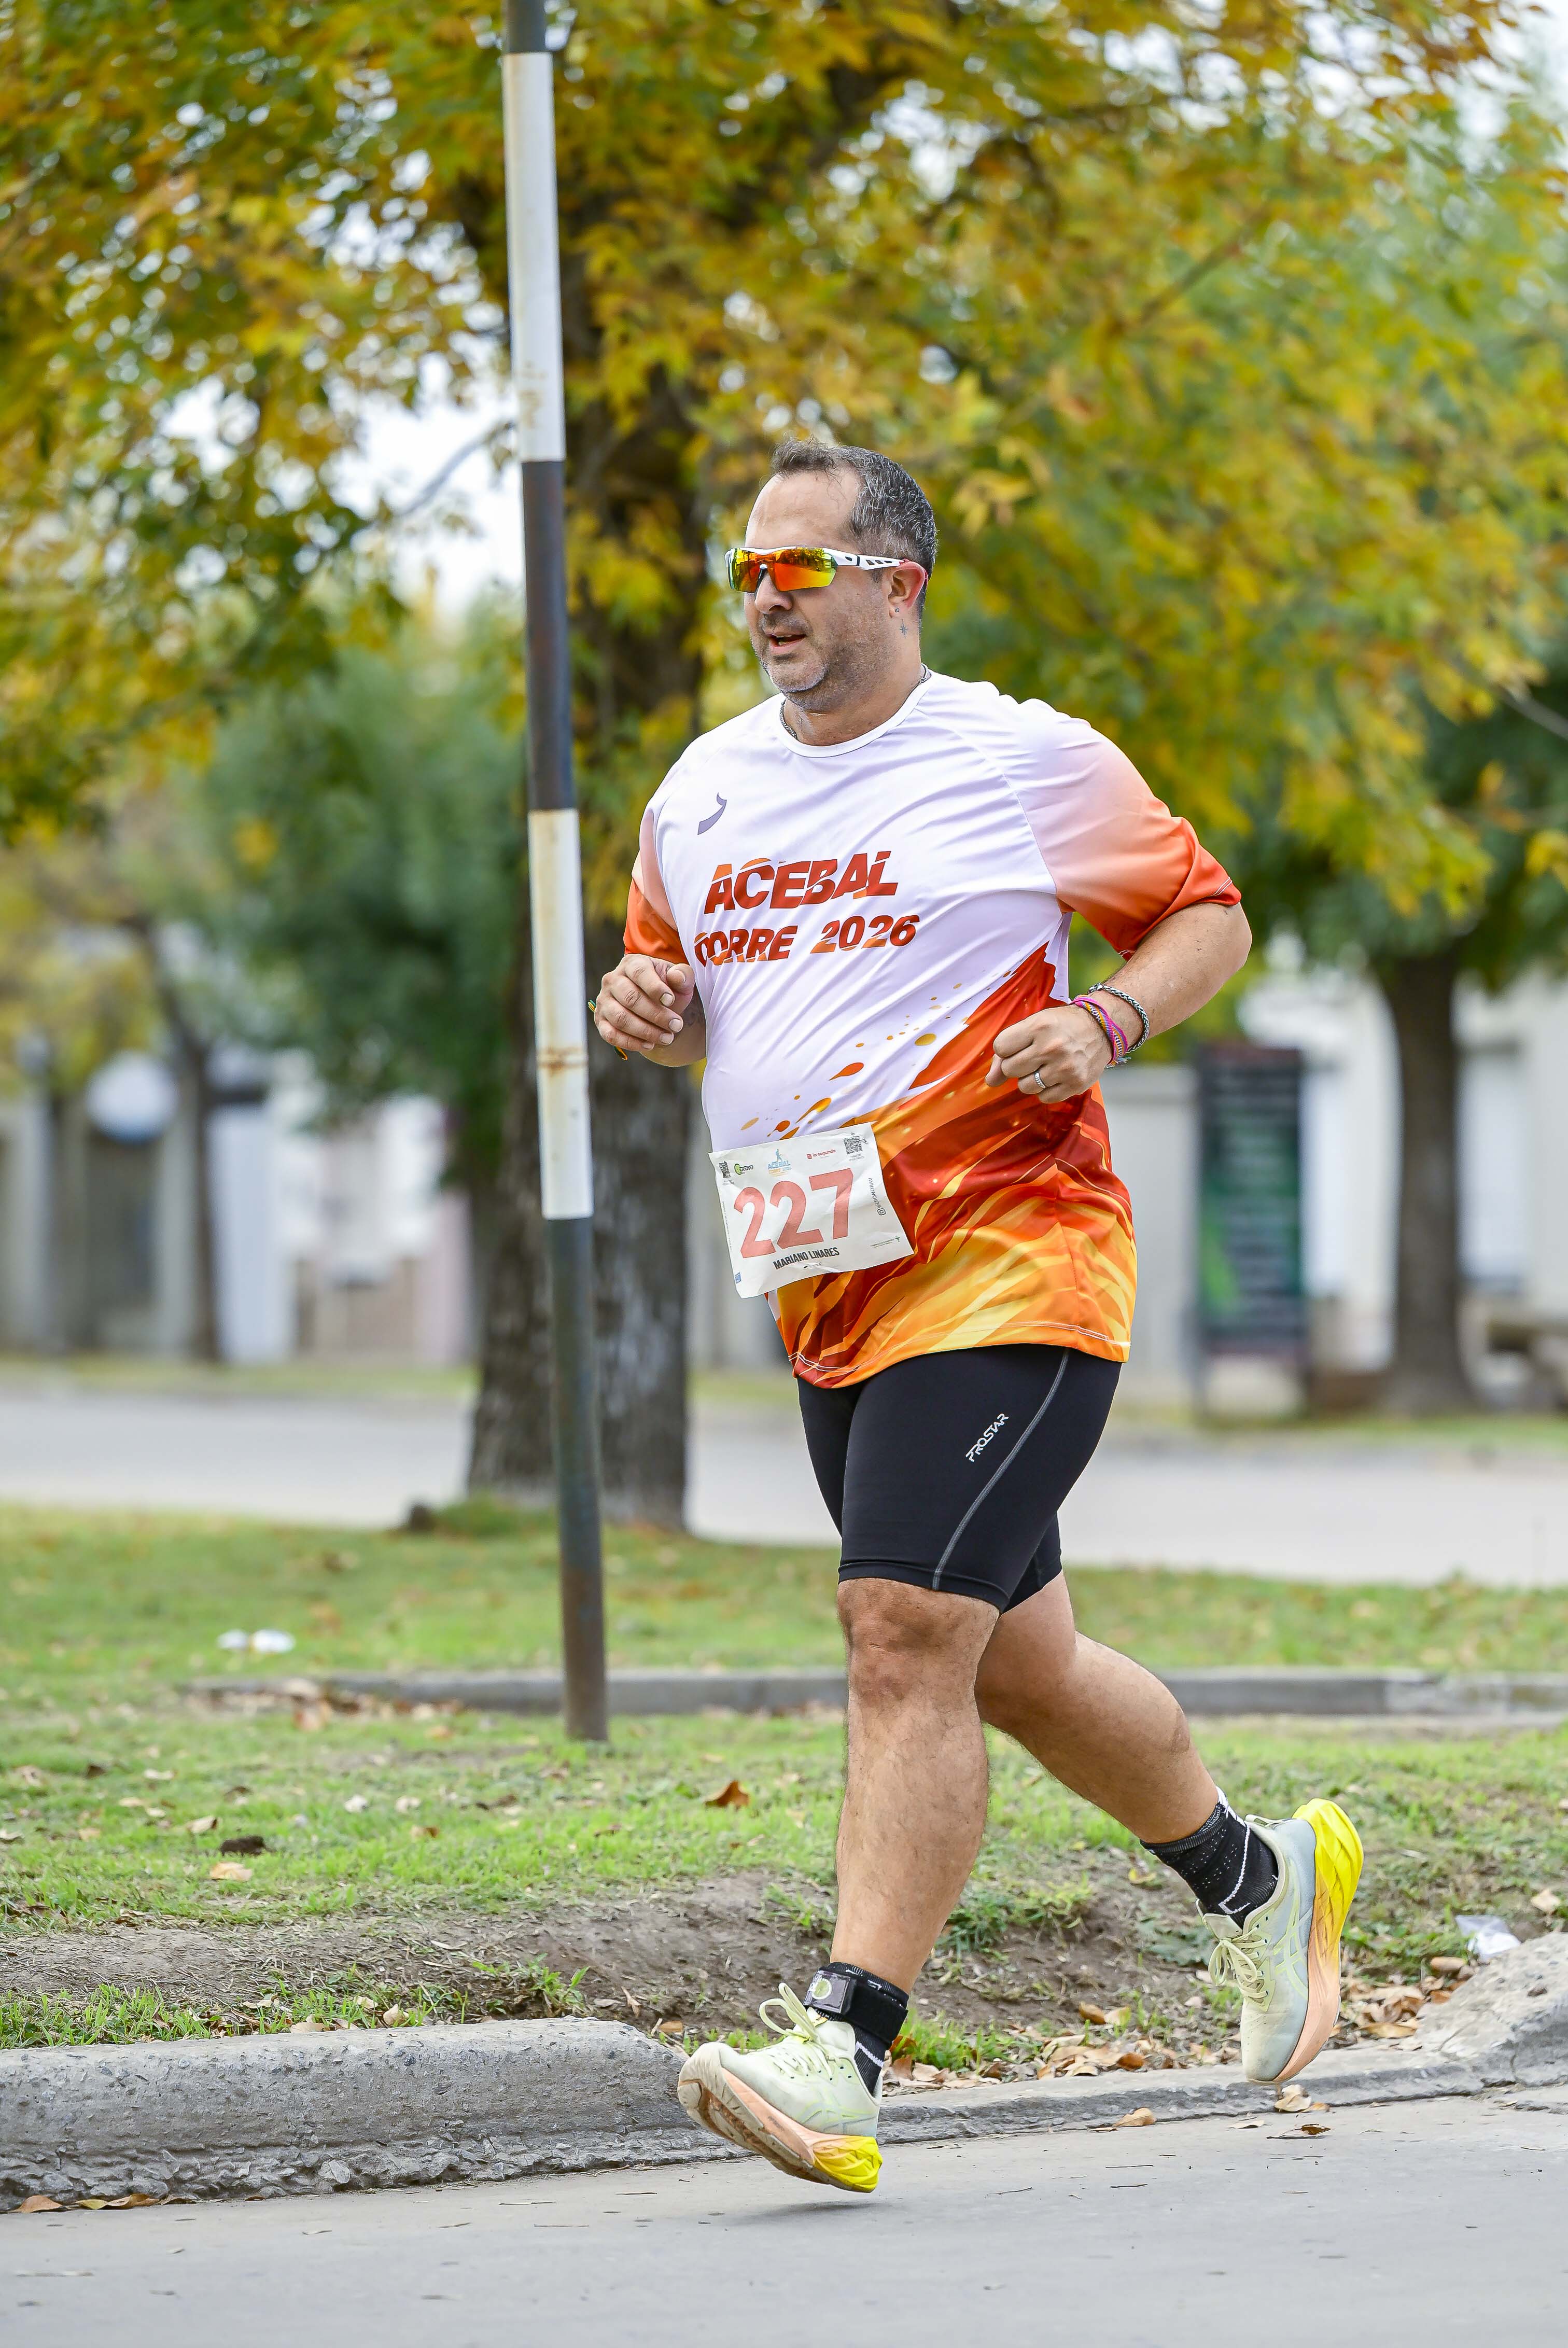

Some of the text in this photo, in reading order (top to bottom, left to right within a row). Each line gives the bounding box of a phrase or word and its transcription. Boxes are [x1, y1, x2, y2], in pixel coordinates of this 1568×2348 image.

[704, 850, 898, 914] ACEBAL
[694, 914, 920, 968] CORRE 2026
[734, 1168, 853, 1259] 227
[773, 1247, 840, 1270] MARIANO LINARES
